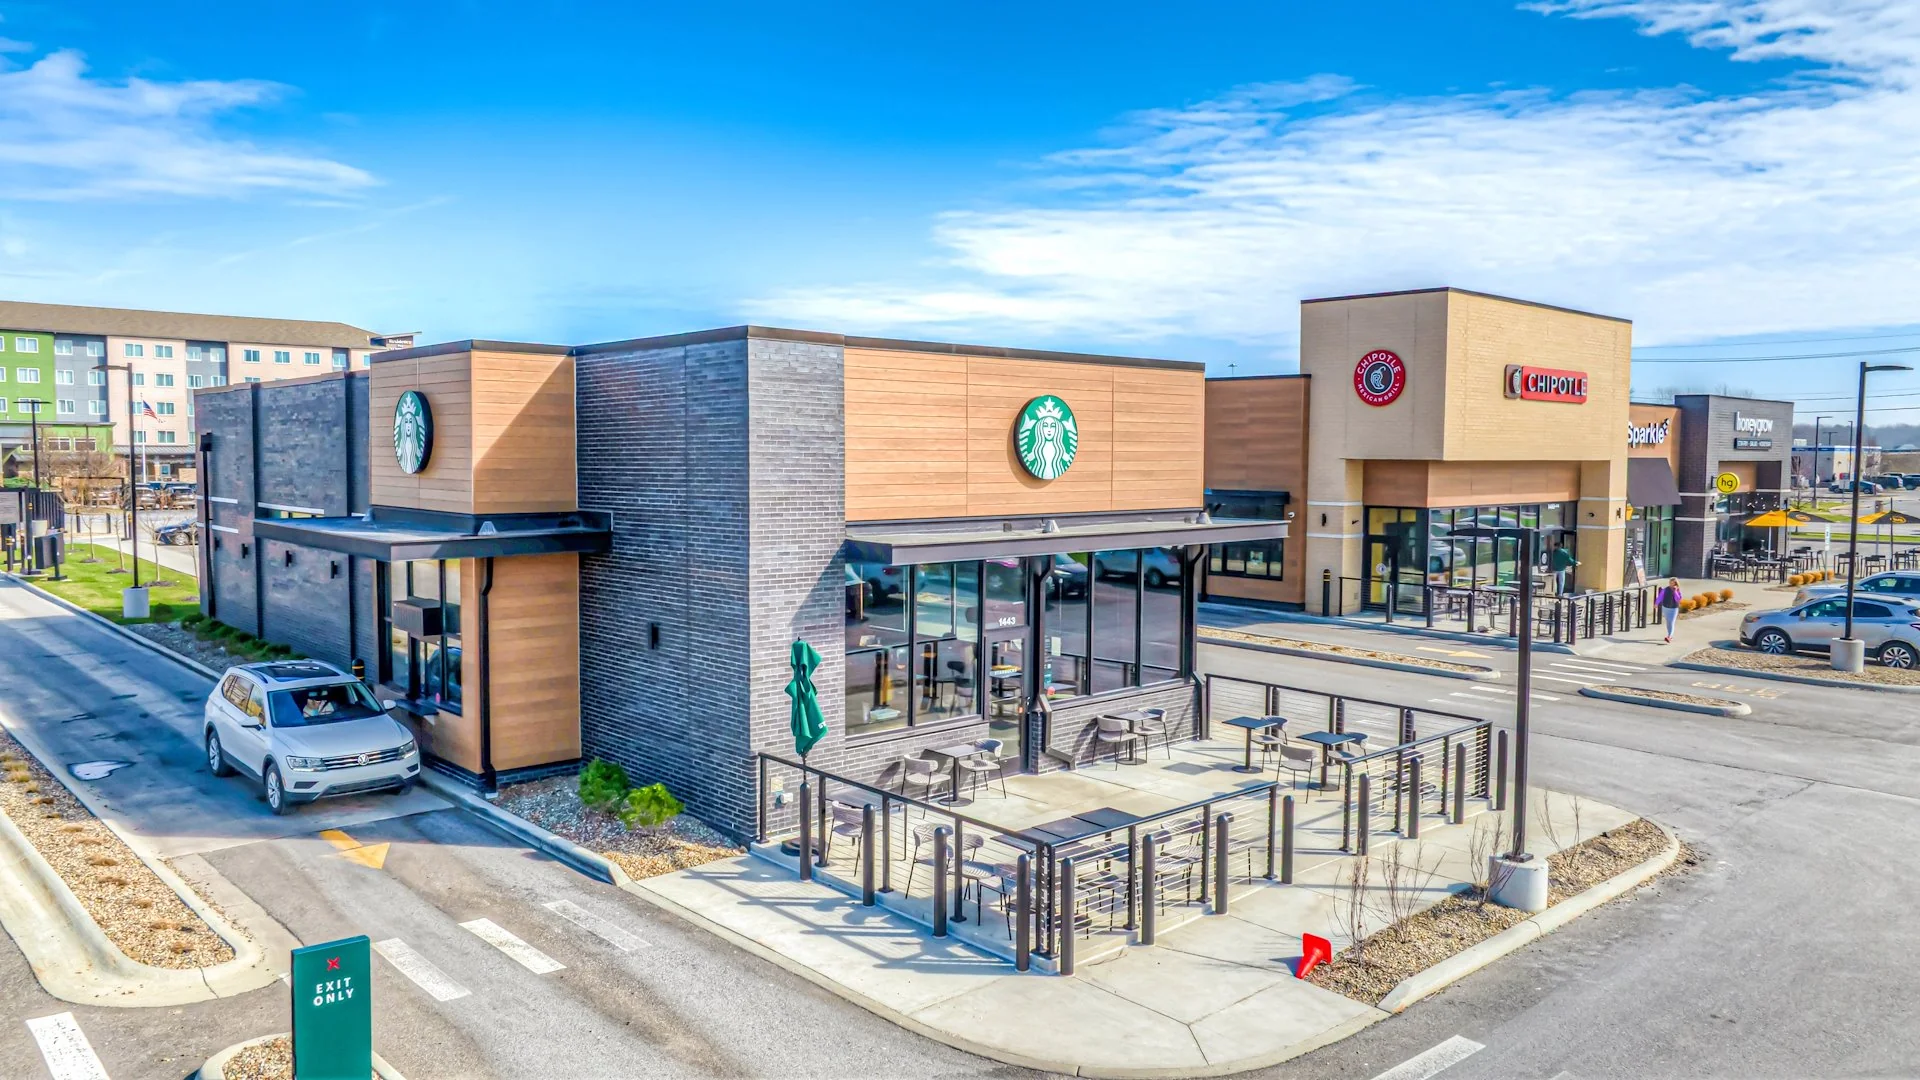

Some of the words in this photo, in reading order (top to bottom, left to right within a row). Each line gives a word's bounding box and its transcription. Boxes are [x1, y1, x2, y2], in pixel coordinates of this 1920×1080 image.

[1357, 352, 1401, 374] CHIPOTLE
[1358, 383, 1383, 402] MEXICAN
[1383, 383, 1400, 400] GRILL
[1528, 373, 1587, 396] CHIPOTLE
[1736, 411, 1773, 436] honeygrow
[1627, 421, 1664, 448] Sparkle
[1721, 477, 1733, 489] hg
[998, 616, 1016, 626] 1443
[316, 977, 351, 994] EXIT
[313, 988, 354, 1006] ONLY
